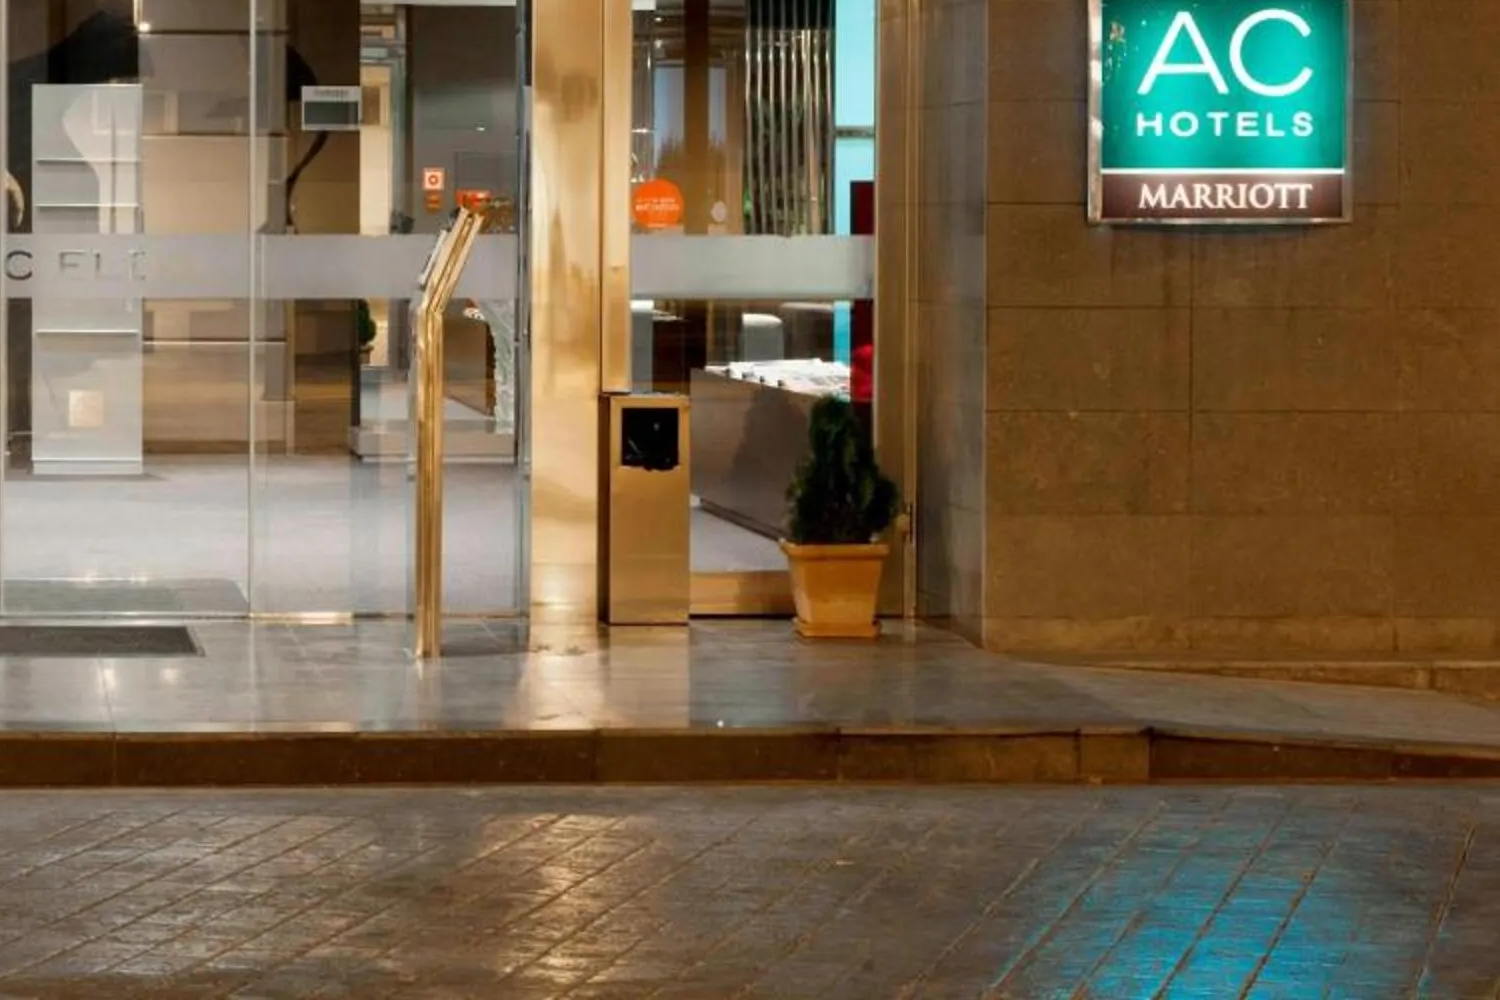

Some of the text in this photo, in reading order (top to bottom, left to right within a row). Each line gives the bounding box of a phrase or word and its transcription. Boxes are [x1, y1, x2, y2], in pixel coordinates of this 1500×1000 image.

[1136, 7, 1314, 97] AC
[1135, 110, 1314, 138] HOTELS
[1138, 182, 1313, 210] MARRIOTT
